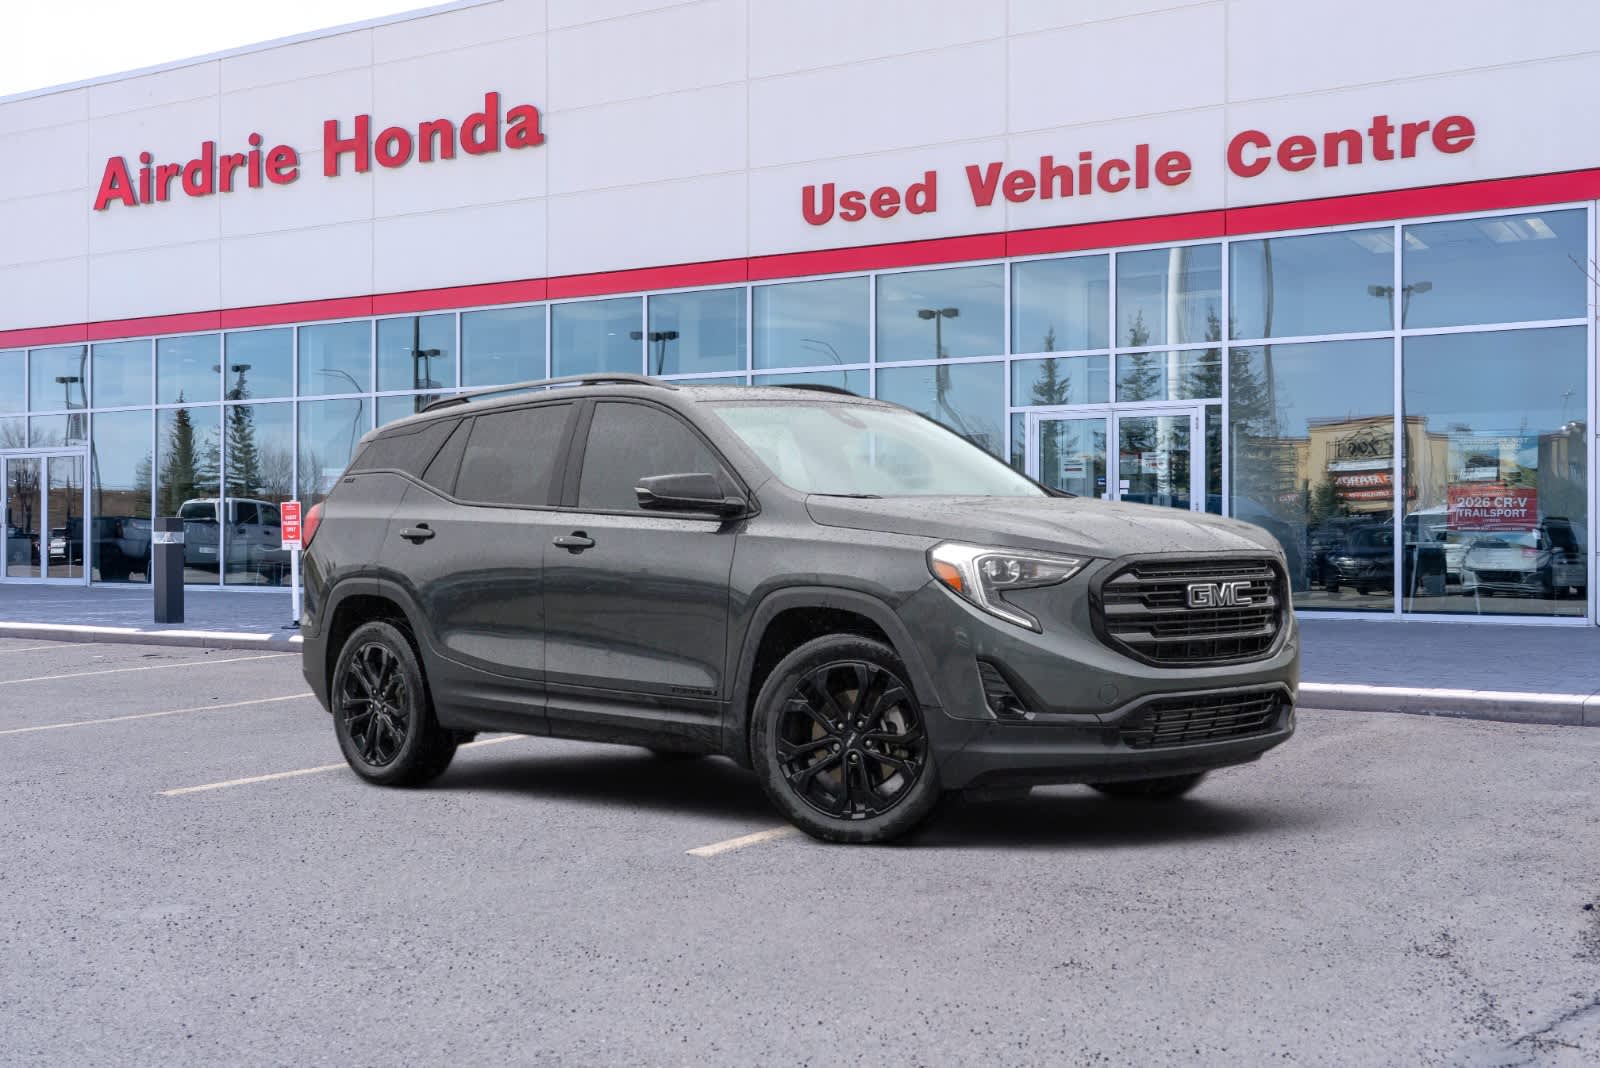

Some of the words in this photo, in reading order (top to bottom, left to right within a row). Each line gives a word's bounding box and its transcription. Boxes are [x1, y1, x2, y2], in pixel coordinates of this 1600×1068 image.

[93, 132, 298, 211] Airdrie
[323, 91, 546, 177] Honda
[802, 170, 937, 226] Used
[965, 143, 1192, 208] Vehicle
[1227, 115, 1476, 178] Centre
[1456, 497, 1490, 508] 2026
[1494, 497, 1528, 508] CR-V
[1457, 508, 1528, 517] TRAILSPORT
[1187, 581, 1252, 608] GMC
